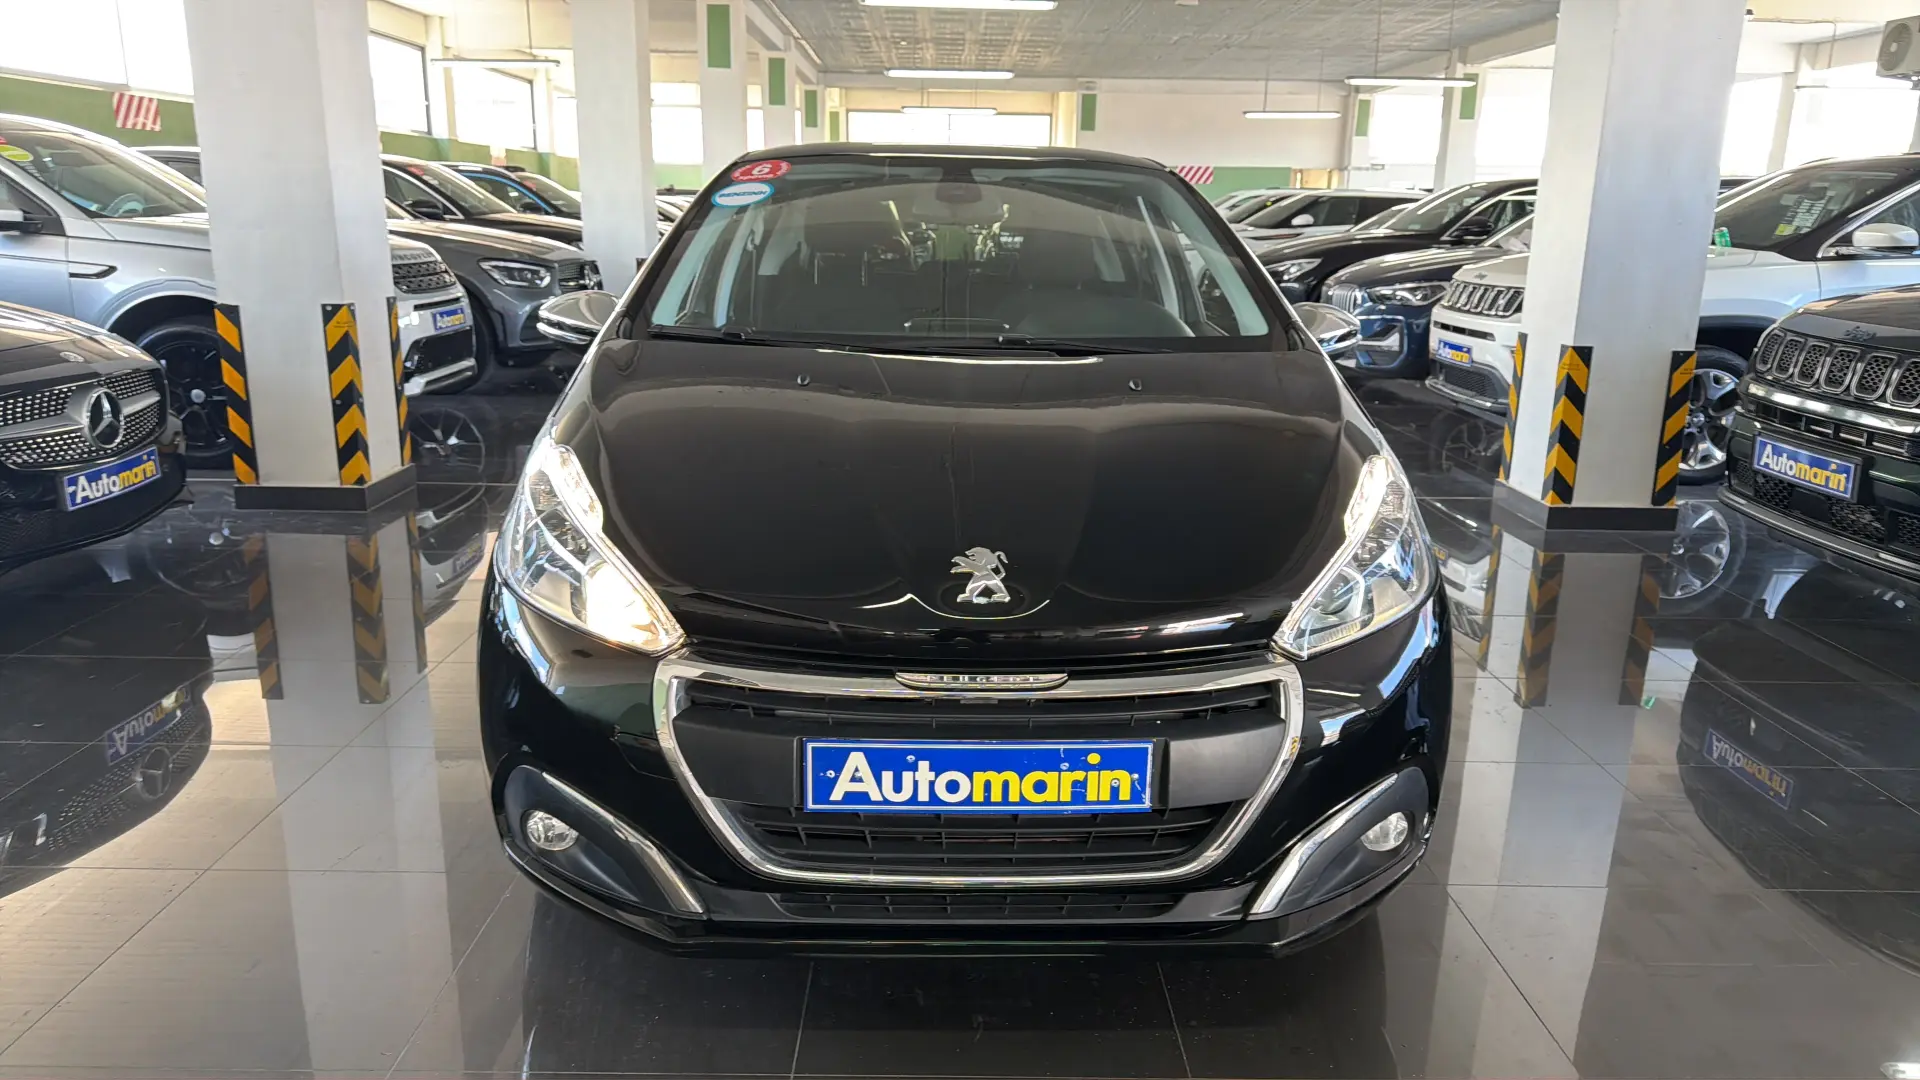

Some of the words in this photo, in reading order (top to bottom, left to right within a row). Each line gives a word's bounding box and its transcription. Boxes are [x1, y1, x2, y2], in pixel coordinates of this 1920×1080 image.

[752, 163, 772, 176] 6
[76, 455, 156, 503] Automarin
[1760, 444, 1846, 491] Automarin
[829, 752, 1131, 803] Automarin
